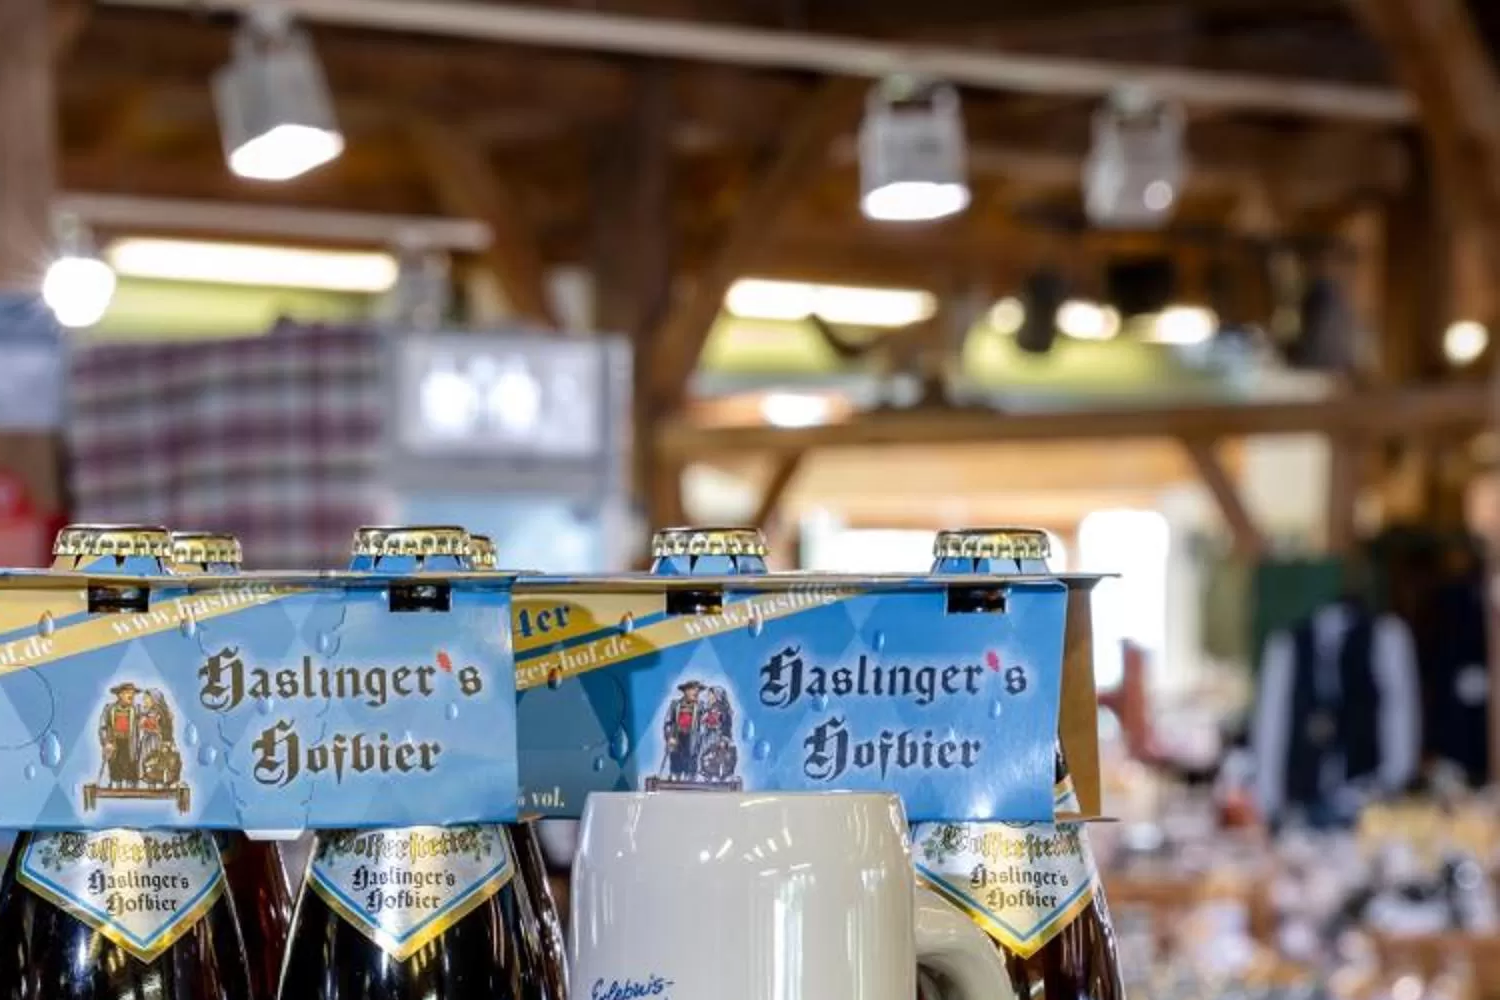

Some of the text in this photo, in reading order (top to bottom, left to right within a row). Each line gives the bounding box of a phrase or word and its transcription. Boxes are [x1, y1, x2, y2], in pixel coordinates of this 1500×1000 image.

[199, 646, 483, 712] Haslinger's
[759, 645, 1028, 708] Haslinger's
[253, 719, 442, 787] Hofbier
[804, 716, 981, 783] Hofbier
[532, 788, 565, 808] vol.
[106, 894, 177, 916] Hofbier
[366, 888, 441, 912] Hofbier
[986, 888, 1057, 909] Hofbier
